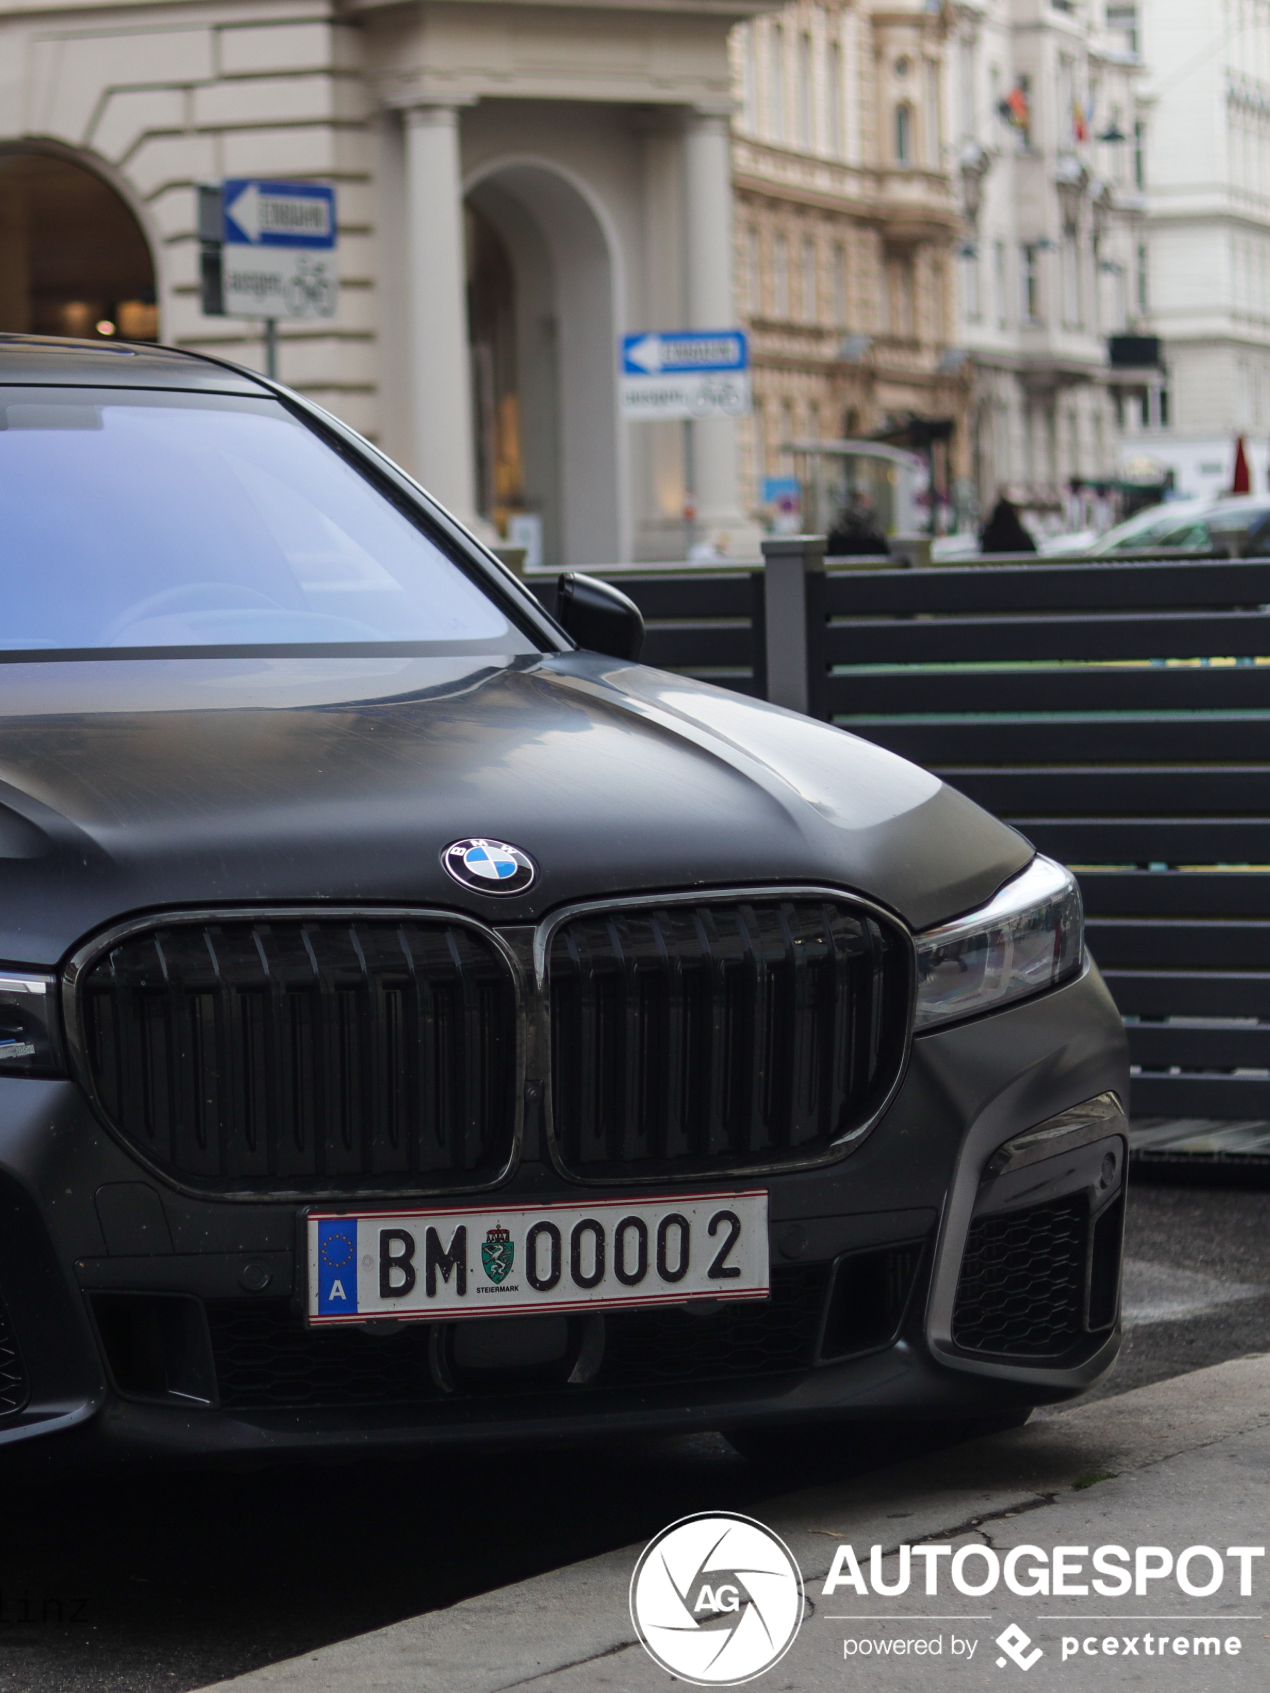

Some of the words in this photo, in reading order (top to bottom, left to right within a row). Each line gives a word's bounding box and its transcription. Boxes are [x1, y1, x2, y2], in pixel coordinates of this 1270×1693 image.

[450, 840, 517, 856] BMW
[379, 1224, 467, 1298] BM
[328, 1279, 347, 1300] A
[476, 1285, 520, 1294] STEIERMARK
